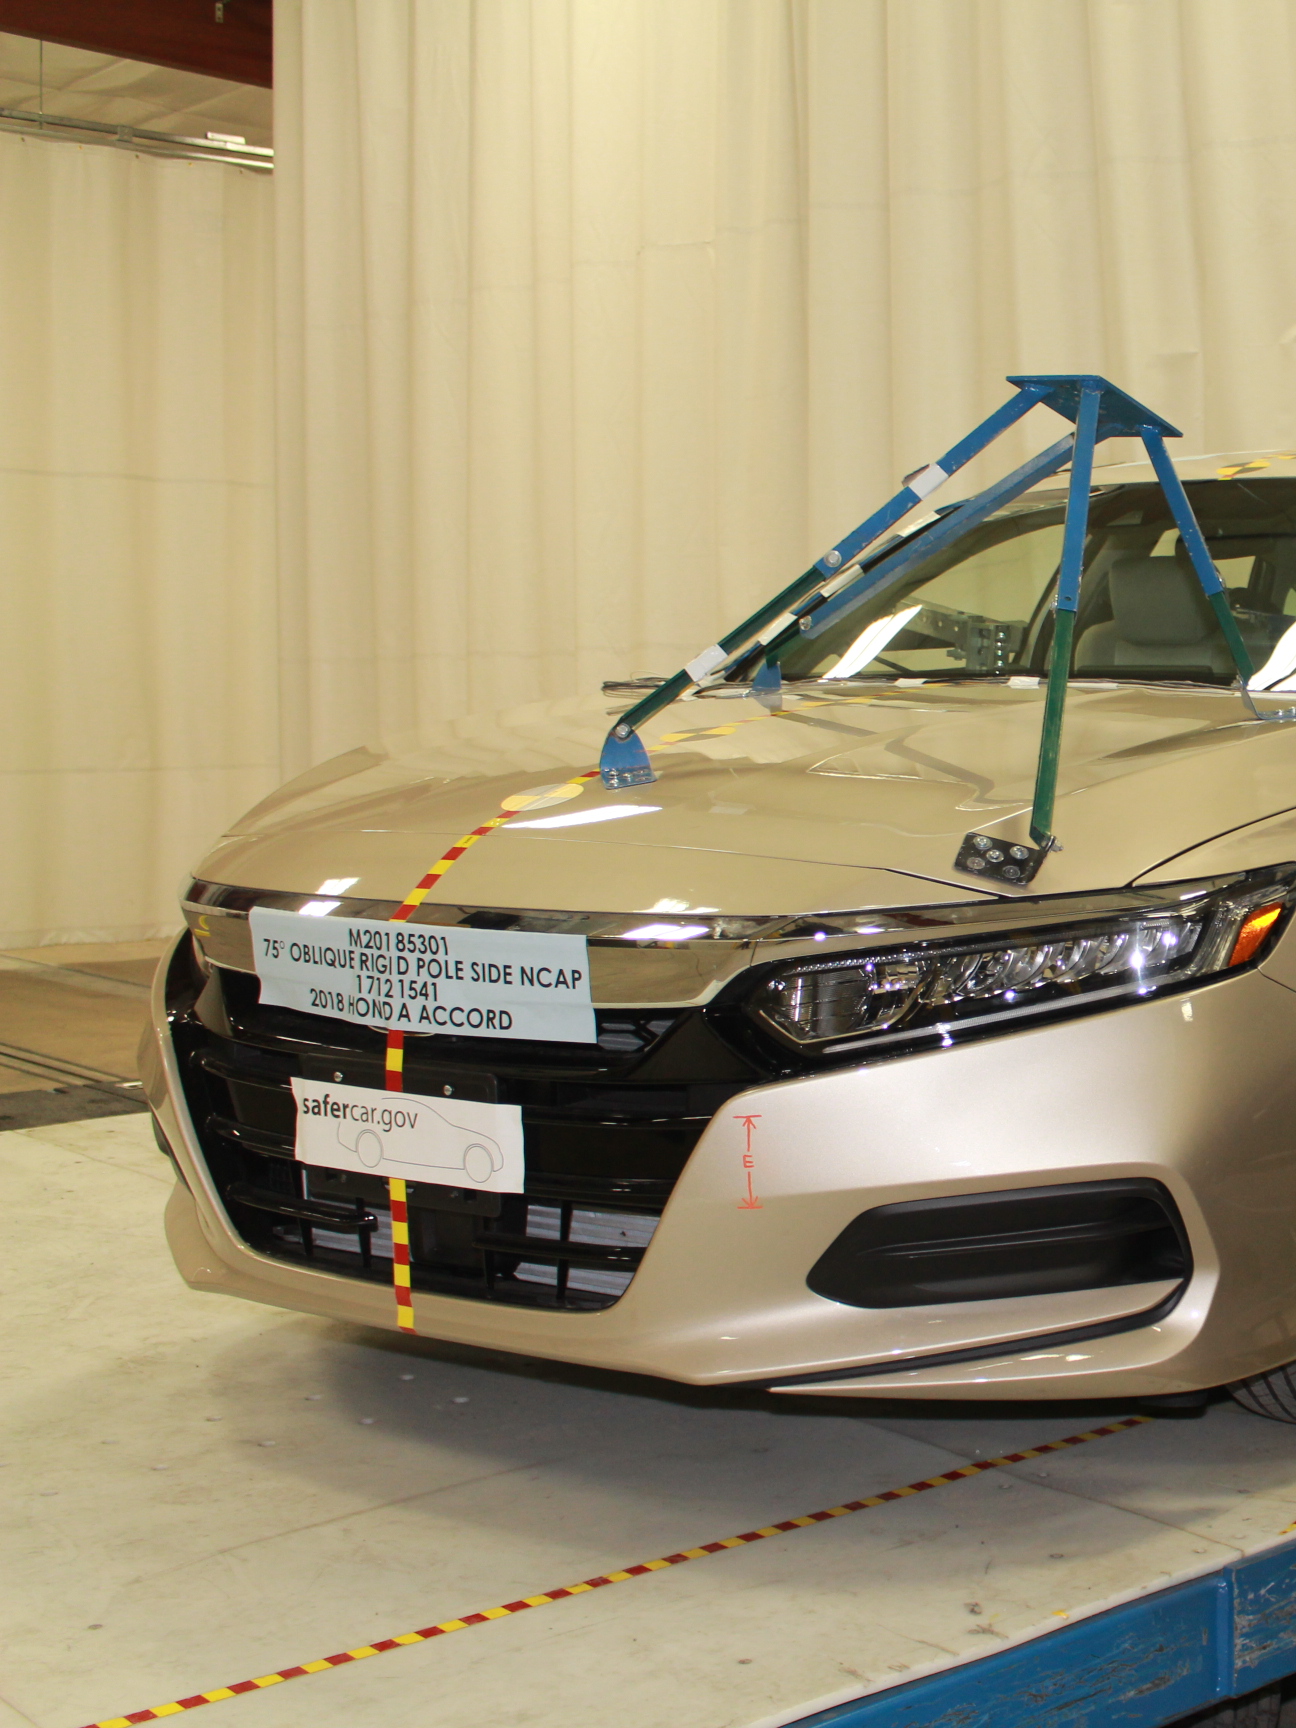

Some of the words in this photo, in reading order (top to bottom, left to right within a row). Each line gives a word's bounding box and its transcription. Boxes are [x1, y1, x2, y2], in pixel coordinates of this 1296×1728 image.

[349, 928, 449, 956] M20185301
[290, 942, 355, 969] OBLIQUE
[360, 952, 409, 976] RIGID
[417, 957, 464, 980] POLE
[471, 961, 513, 985] SIDE
[520, 966, 582, 989] NCAP
[356, 974, 438, 1002] 17121541
[310, 988, 345, 1012] 2018
[349, 995, 411, 1022] HONDA
[418, 1004, 513, 1030] ACCORD
[303, 1093, 418, 1132] safercar.gov
[742, 1154, 755, 1168] E
